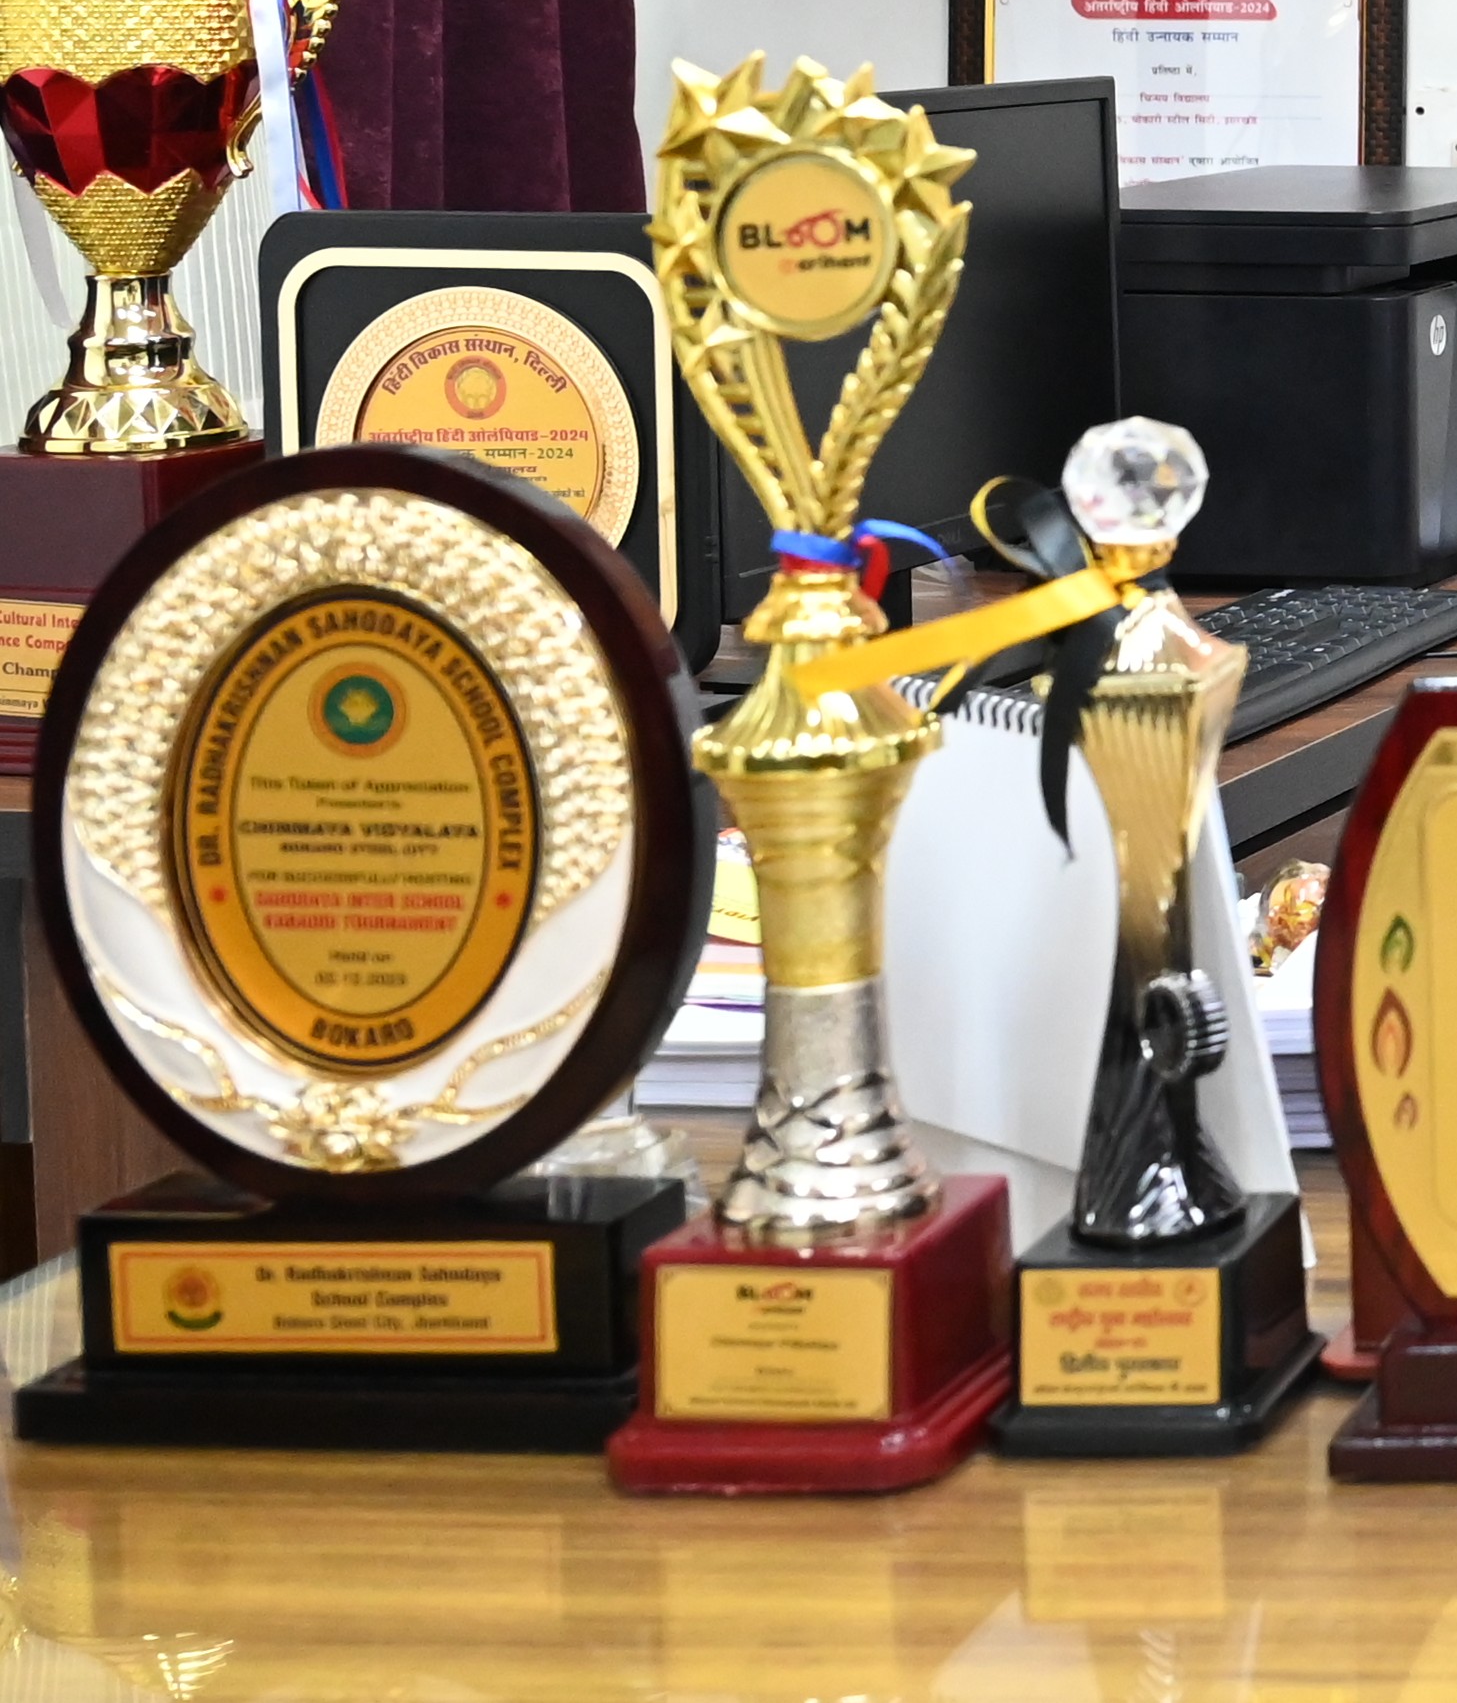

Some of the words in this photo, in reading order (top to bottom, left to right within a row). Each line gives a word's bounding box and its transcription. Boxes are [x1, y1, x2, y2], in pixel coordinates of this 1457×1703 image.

[382, 363, 414, 396] हिंदी
[409, 338, 461, 371] विकास
[524, 351, 568, 394] दिल्ली
[436, 427, 465, 443] हिंदी
[52, 614, 80, 629] Inte
[25, 634, 66, 653] Comp
